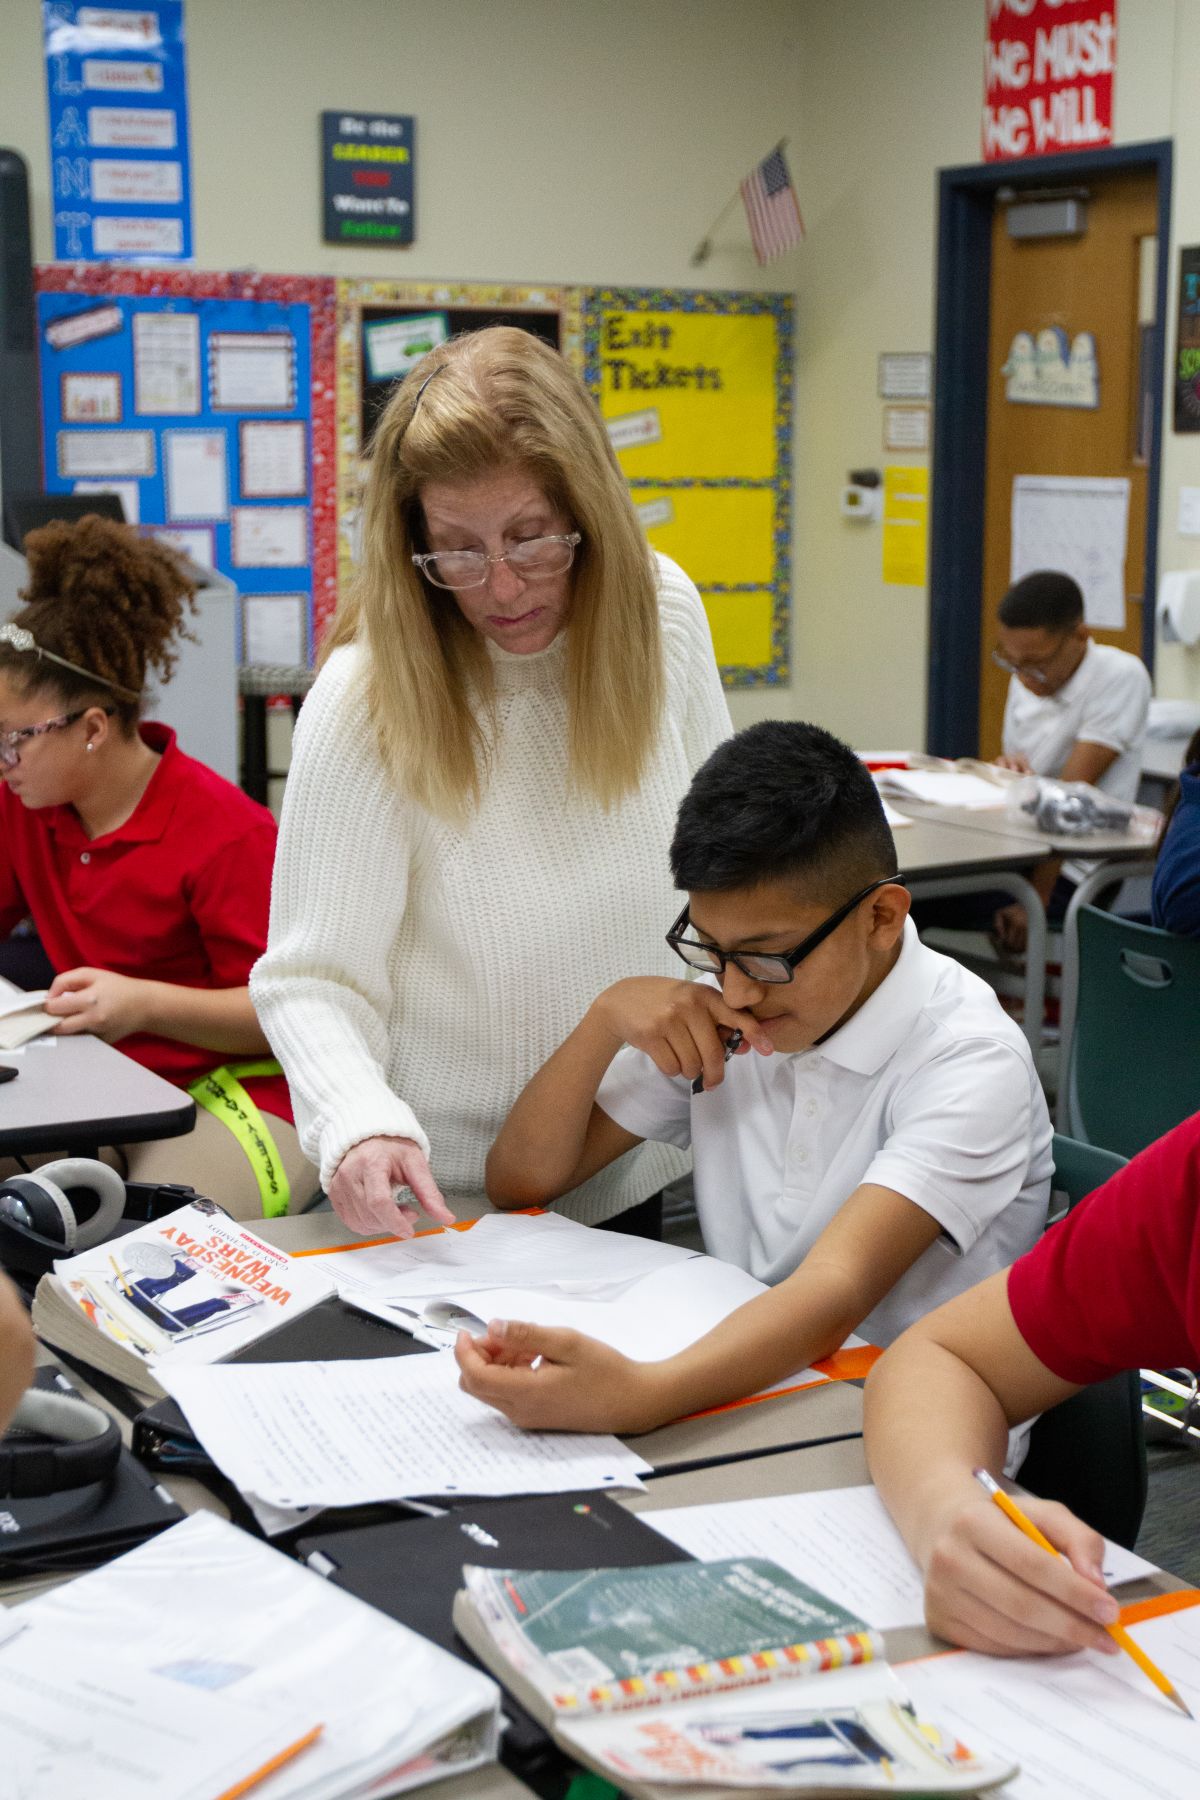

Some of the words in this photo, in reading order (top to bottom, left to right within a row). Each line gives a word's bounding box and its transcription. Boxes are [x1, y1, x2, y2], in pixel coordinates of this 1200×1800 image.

[606, 315, 672, 350] Exit
[605, 359, 722, 390] Tickets
[160, 1226, 292, 1306] WEDNESDAY
[206, 1236, 272, 1279] WARS
[262, 1255, 289, 1272] GARY
